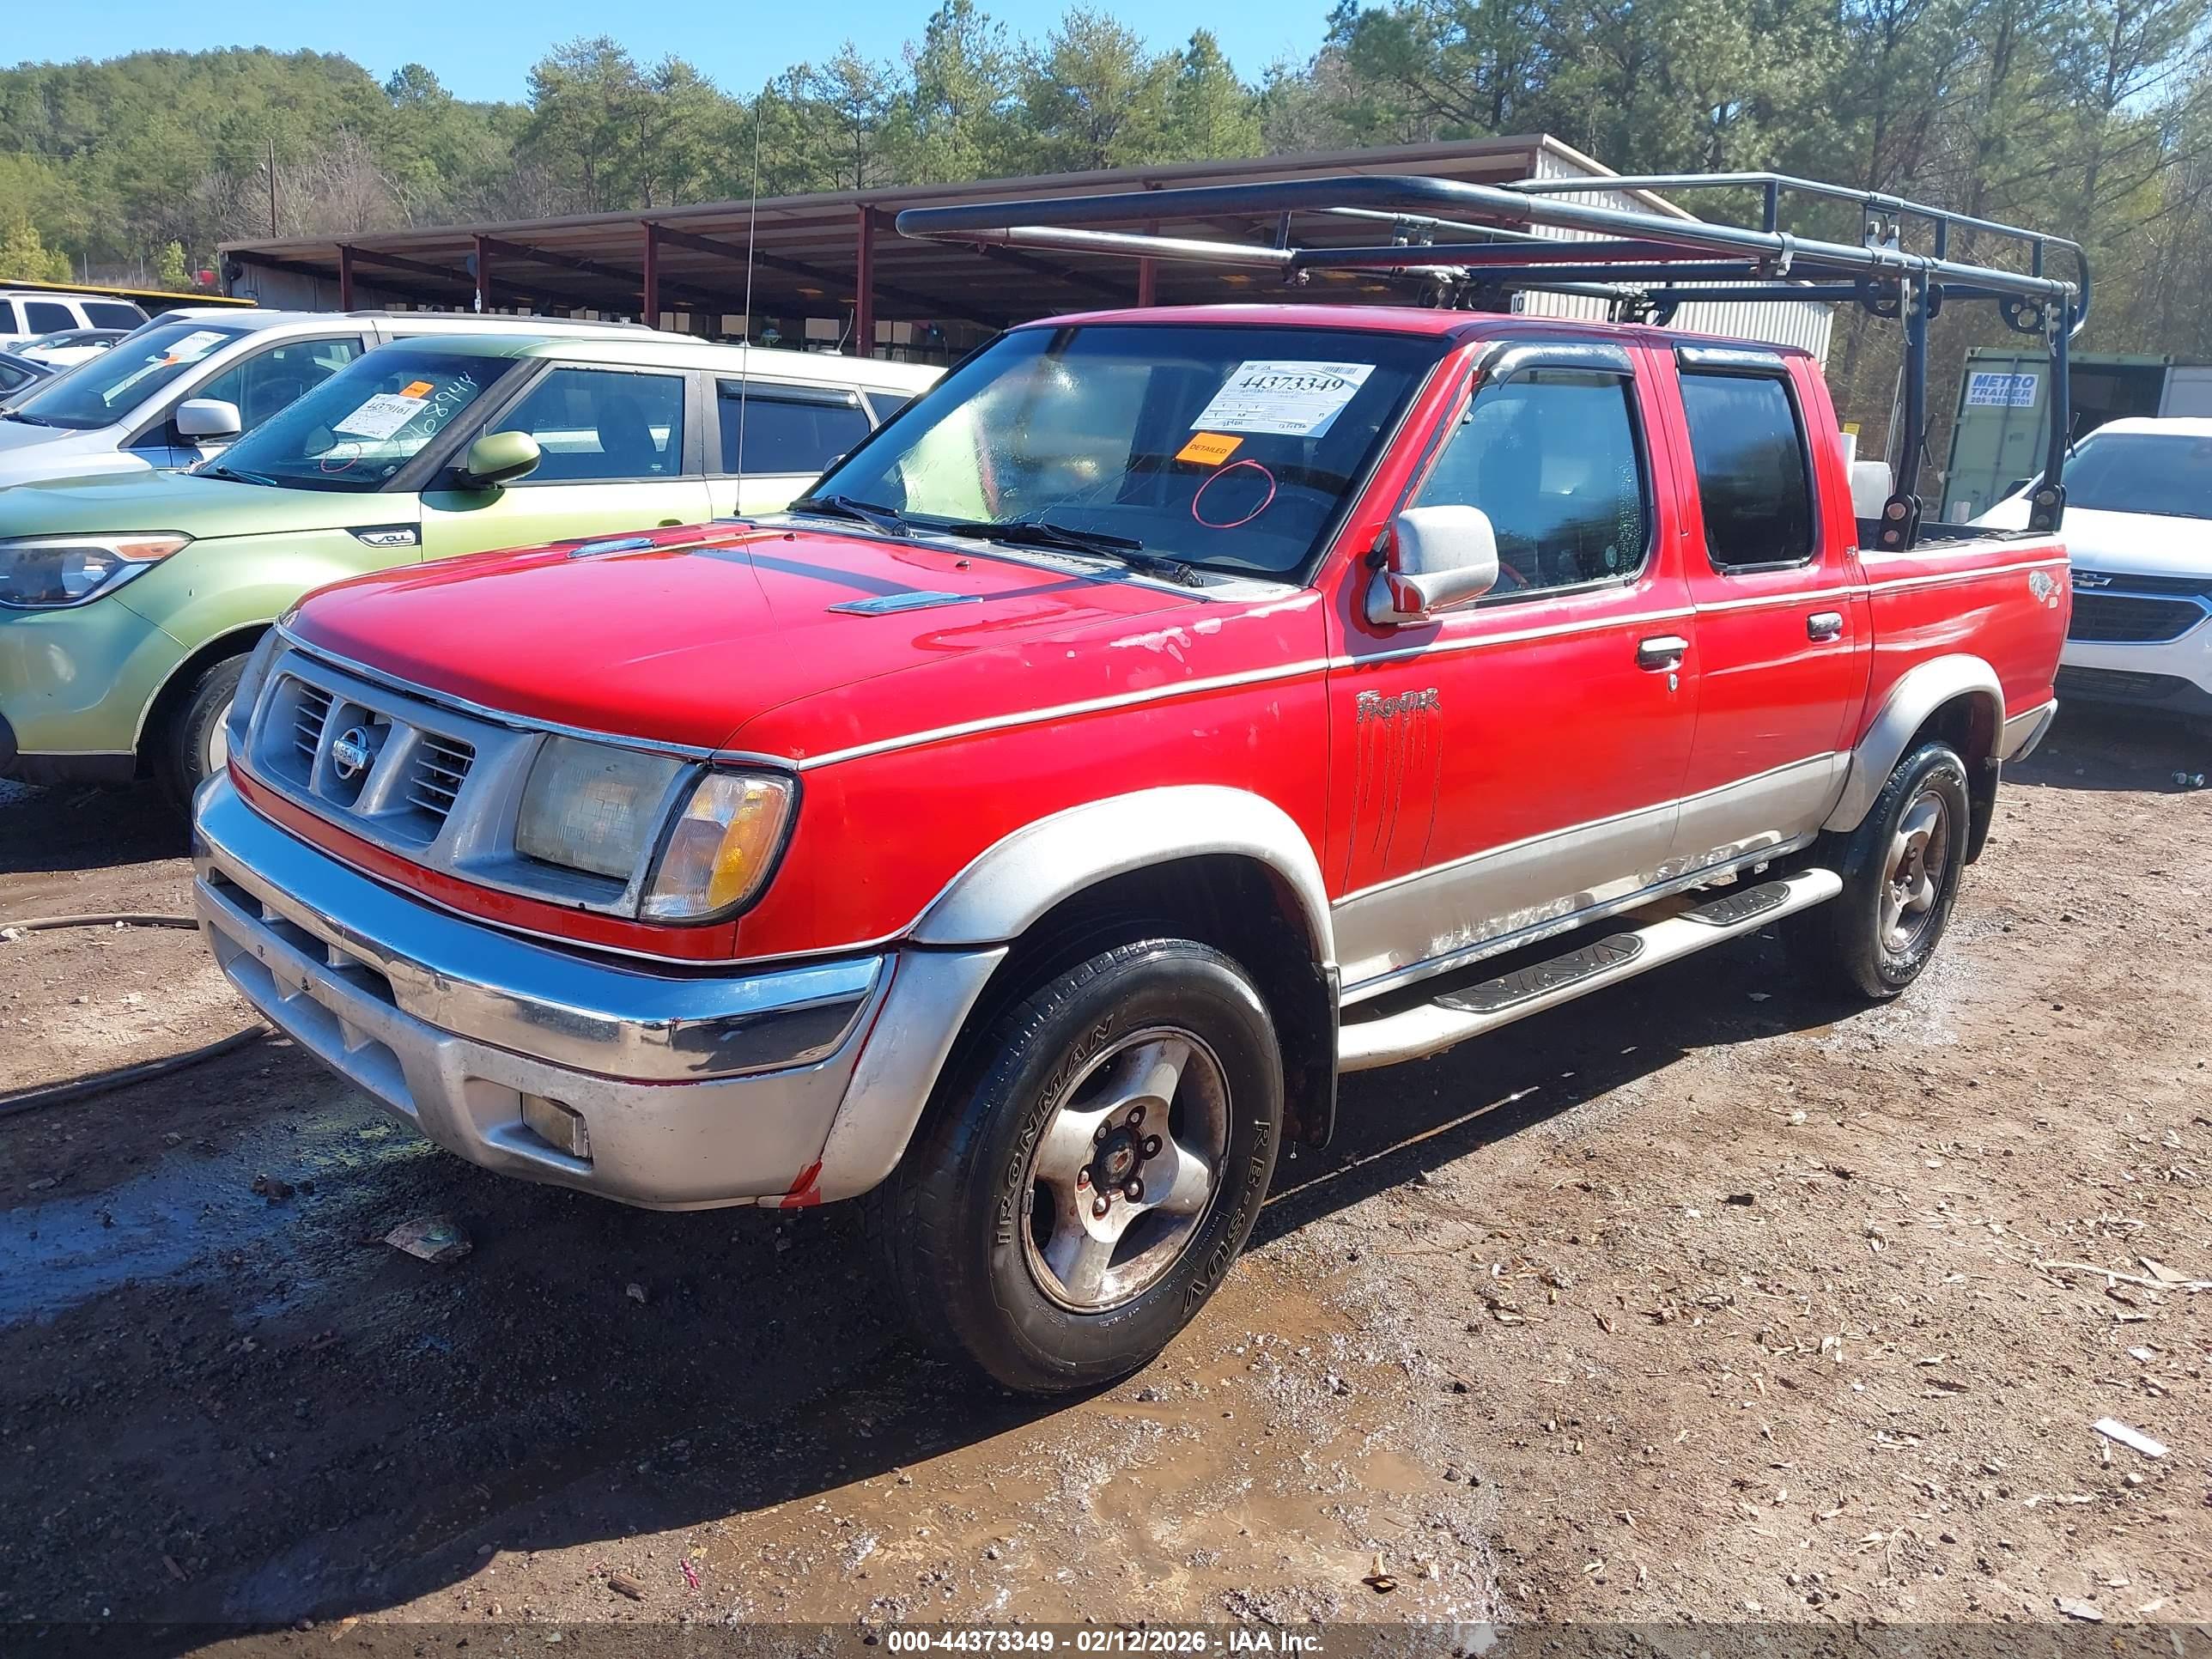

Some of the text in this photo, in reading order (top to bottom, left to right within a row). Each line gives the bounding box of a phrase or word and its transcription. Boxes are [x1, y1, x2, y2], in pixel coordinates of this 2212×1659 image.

[1513, 296, 1524, 313] 10
[1239, 376, 1345, 392] 44373349
[1973, 374, 2035, 388] METRO
[1972, 387, 2032, 398] TRAILER
[1189, 444, 1227, 454] DETAILED
[334, 741, 358, 763] NISSAN
[996, 1012, 1115, 1244] IRONMAN
[1182, 1119, 1271, 1314] RB-SUV
